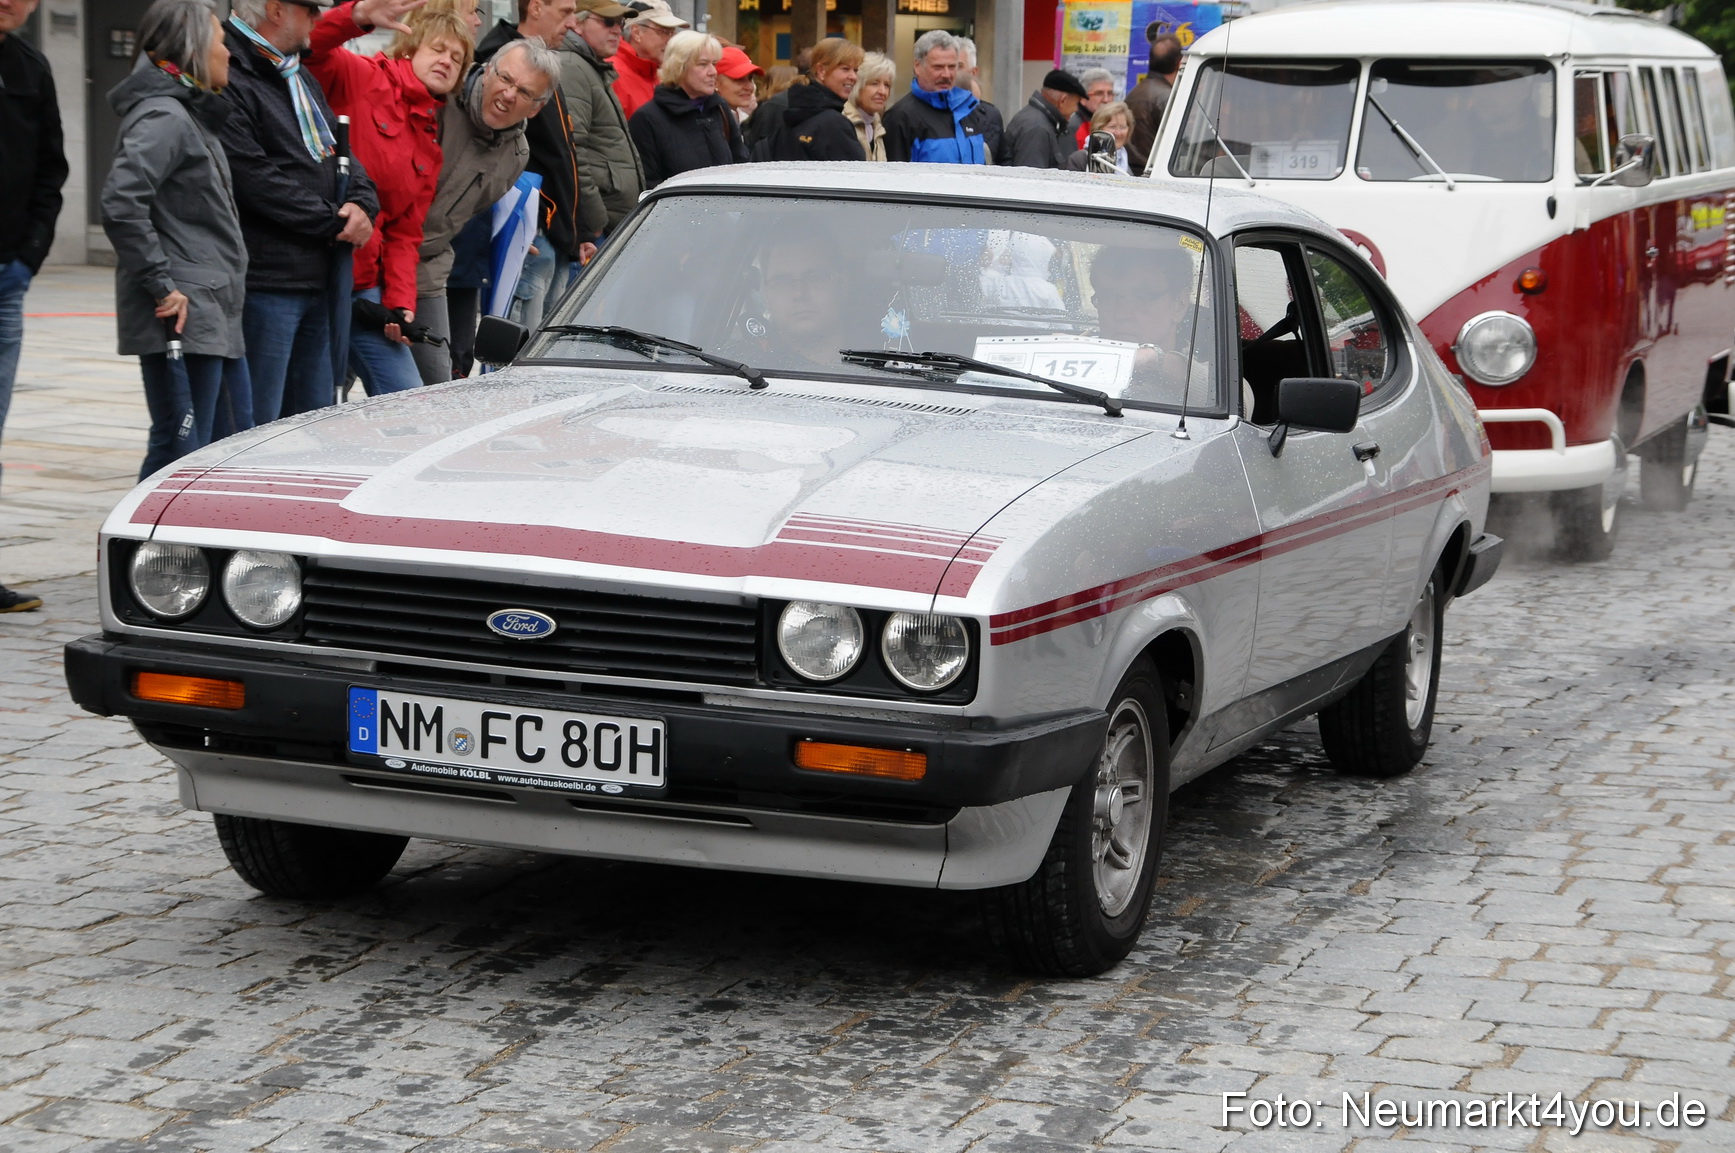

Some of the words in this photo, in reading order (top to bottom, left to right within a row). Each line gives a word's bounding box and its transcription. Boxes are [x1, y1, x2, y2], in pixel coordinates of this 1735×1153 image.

[1108, 44, 1127, 54] 2013
[1289, 155, 1319, 169] 319
[1045, 359, 1098, 378] 157
[502, 614, 540, 633] Ford
[358, 726, 370, 741] D
[380, 698, 443, 754] NM
[481, 710, 546, 764] FC
[561, 719, 661, 777] 80H
[411, 762, 458, 776] Automobile
[459, 768, 492, 780] KÖLBL
[497, 774, 597, 792] www.autohauskoelbl.de
